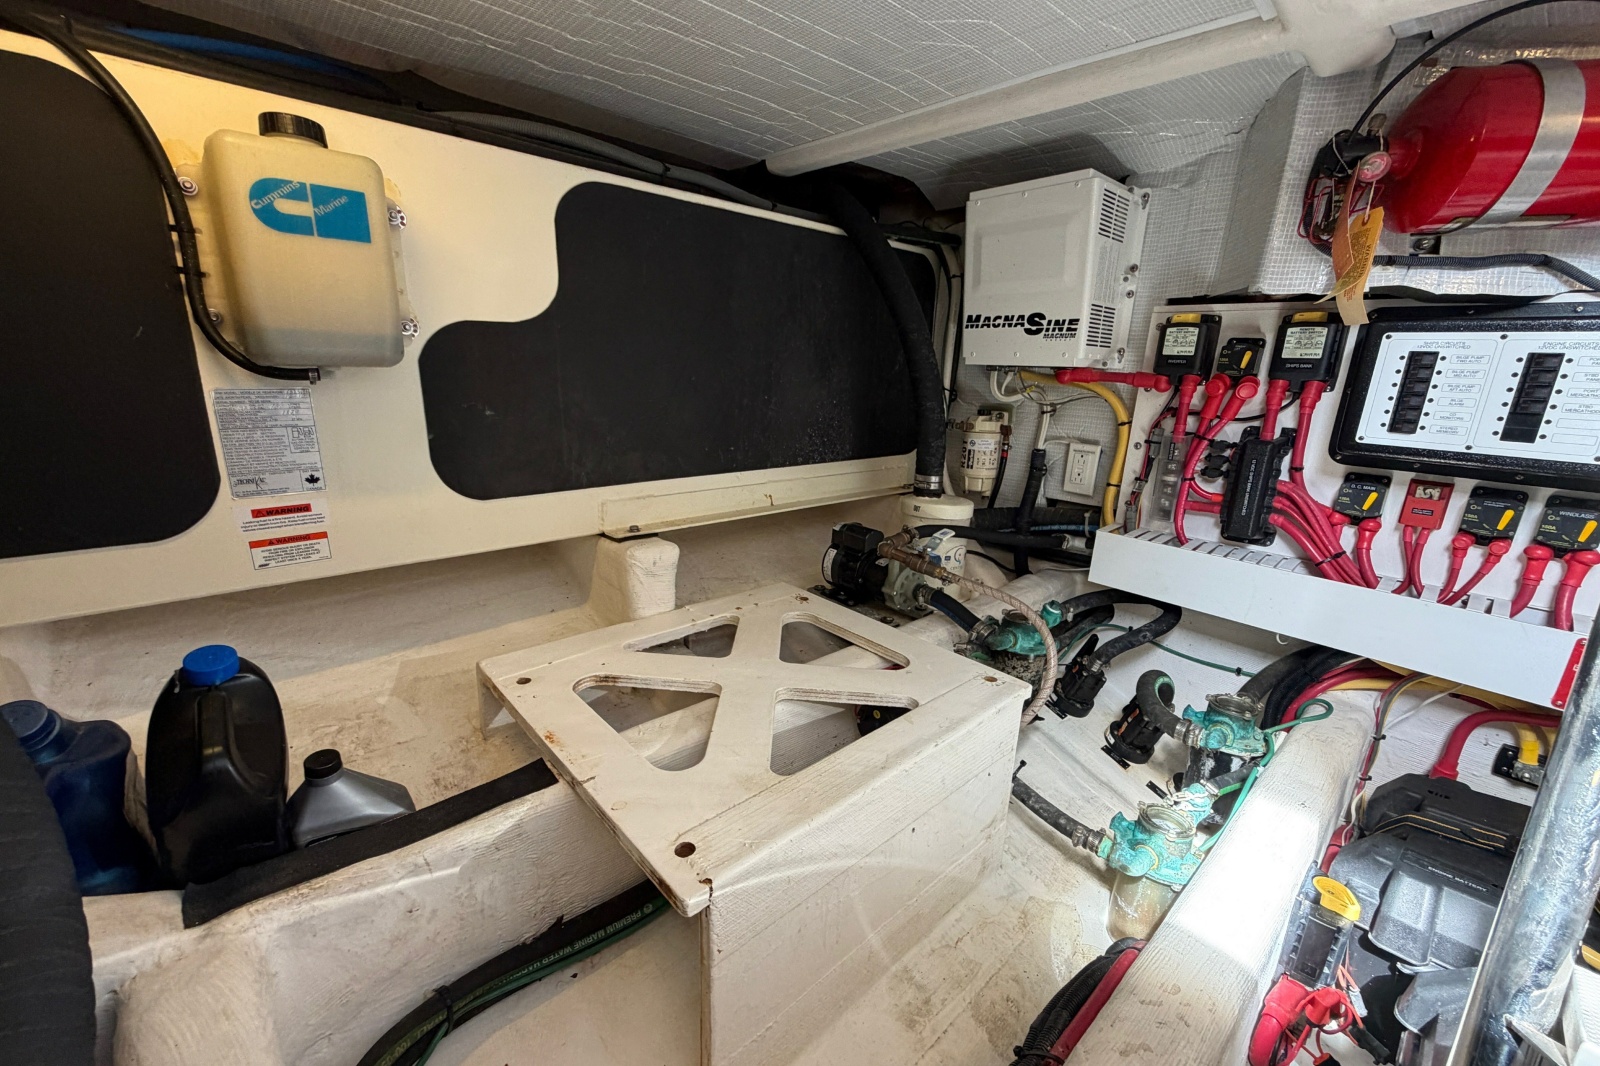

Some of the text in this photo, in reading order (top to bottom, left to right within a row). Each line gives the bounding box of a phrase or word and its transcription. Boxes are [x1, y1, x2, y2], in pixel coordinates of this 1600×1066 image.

[251, 180, 301, 209] Cummins
[313, 195, 349, 216] Marine
[266, 505, 309, 516] WARNING
[1560, 510, 1595, 519] WINDLASS
[276, 535, 311, 544] WARNING
[1454, 876, 1488, 892] BATTERY
[606, 911, 642, 932] PREMIUM
[573, 928, 605, 950] MARINE
